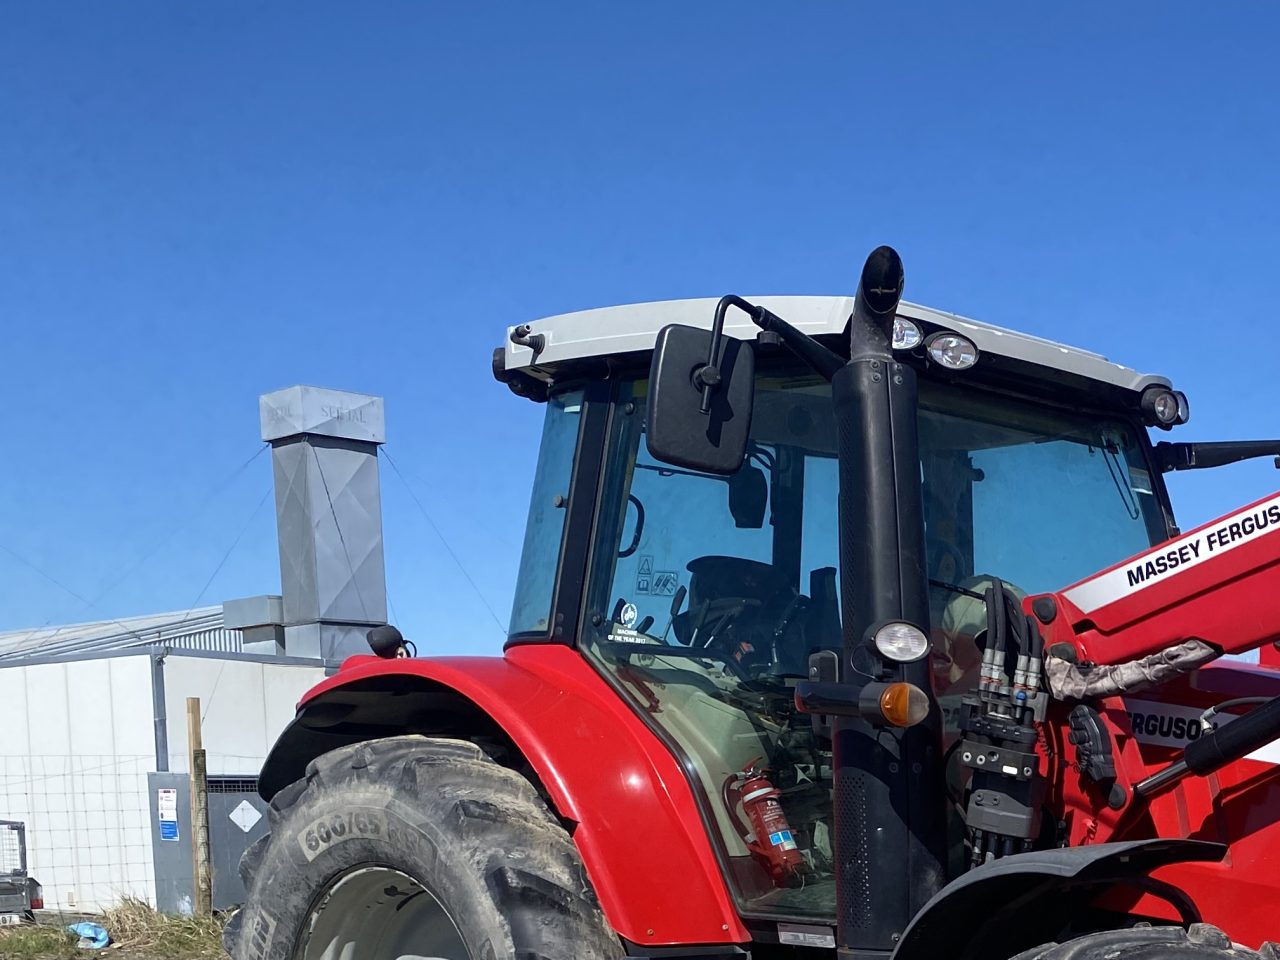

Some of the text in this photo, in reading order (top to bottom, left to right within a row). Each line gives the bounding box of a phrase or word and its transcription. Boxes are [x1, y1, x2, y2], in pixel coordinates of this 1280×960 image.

[1126, 539, 1200, 587] MASSEY
[617, 628, 637, 636] MACHINE
[1127, 711, 1218, 741] RGUSO
